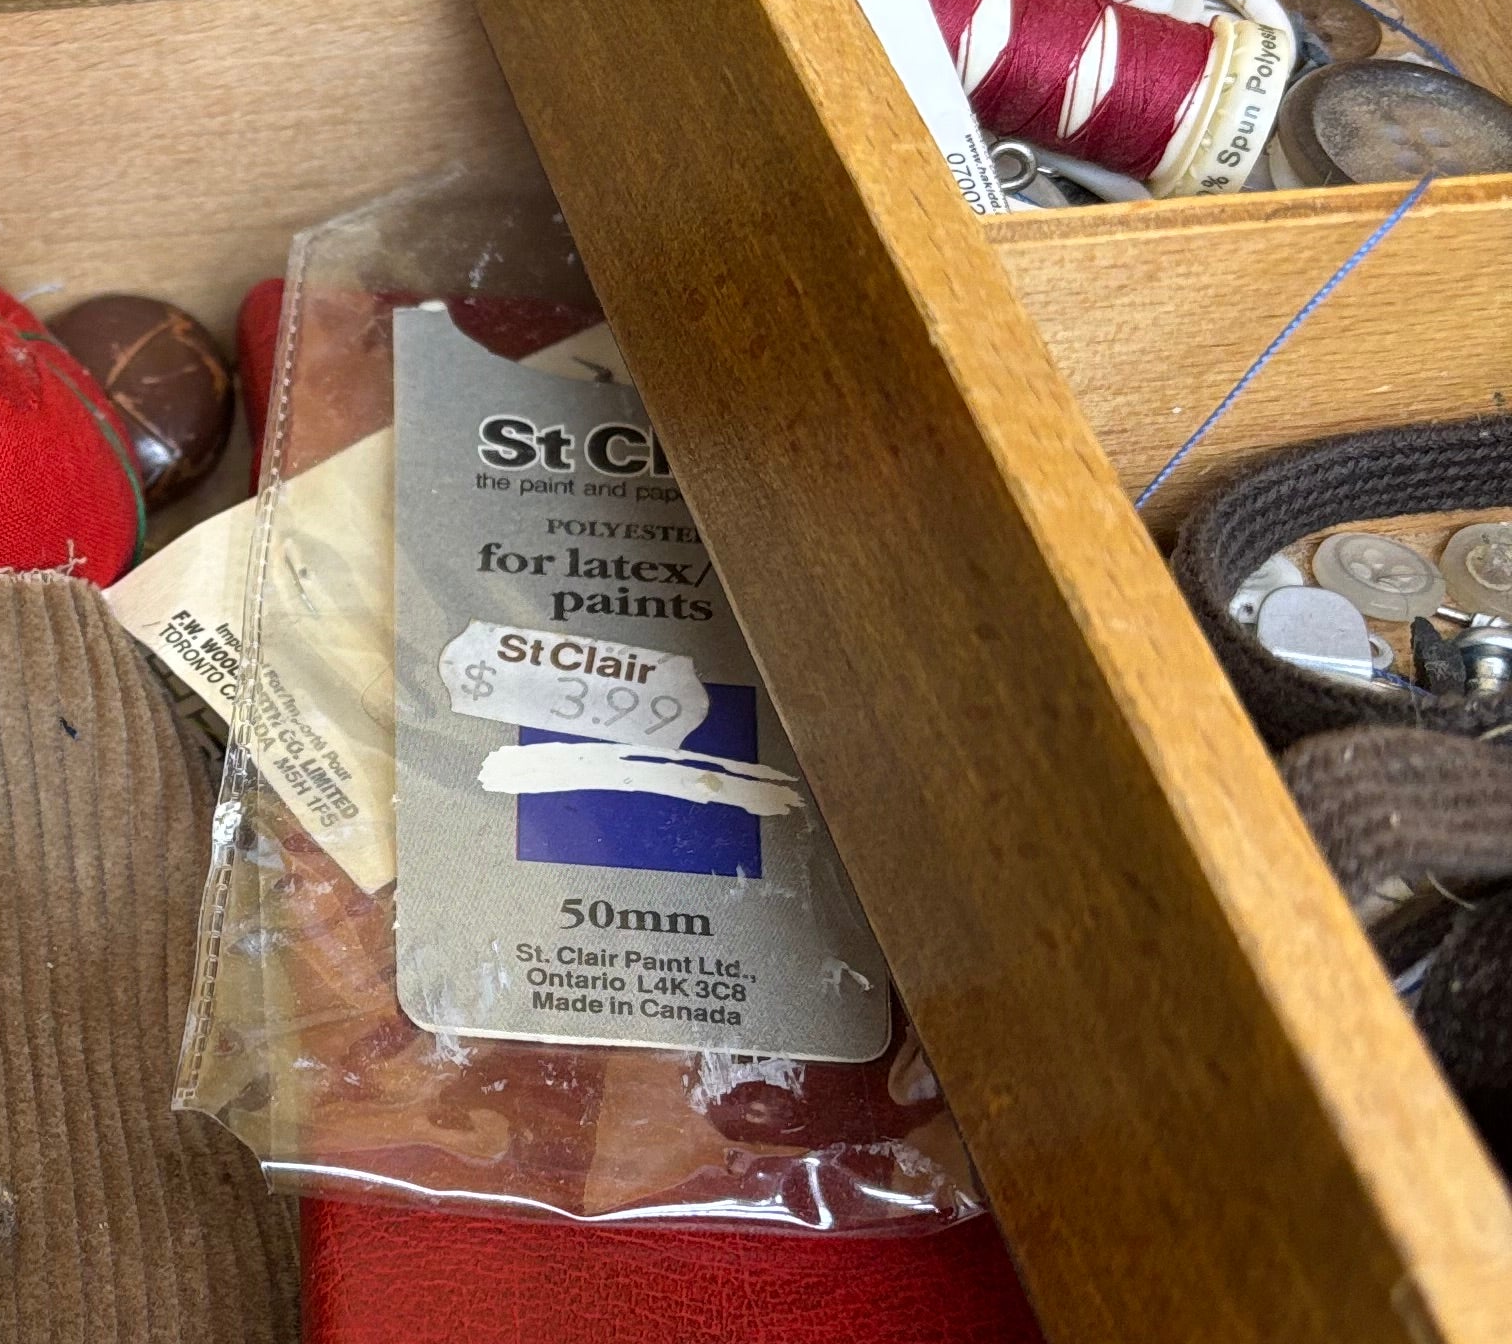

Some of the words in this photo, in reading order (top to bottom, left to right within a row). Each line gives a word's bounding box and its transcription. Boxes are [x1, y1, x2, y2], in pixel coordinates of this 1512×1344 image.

[1216, 105, 1261, 168] Spun
[478, 414, 575, 473] St
[476, 472, 511, 491] the
[520, 478, 575, 497] paint
[584, 480, 627, 499] and
[476, 542, 555, 576] for
[564, 547, 713, 588] latex/
[550, 586, 714, 622] paints
[497, 633, 545, 666] St
[549, 641, 656, 685] Clair
[159, 623, 224, 685] TORONTO
[273, 756, 311, 797] M5H
[172, 609, 206, 641] F.W.
[278, 728, 305, 761] CO.
[299, 757, 360, 821] LIMITED
[549, 676, 683, 736] 3.99
[326, 749, 353, 783] Pour
[560, 898, 715, 936] 50mm
[515, 942, 551, 964] St.
[556, 945, 619, 968] Clair
[624, 950, 693, 975] Paint
[526, 967, 627, 992] Ontario
[638, 974, 689, 998] L4K
[694, 979, 747, 1002] 3C8
[532, 990, 604, 1014] Made
[609, 996, 634, 1016] in
[639, 998, 743, 1026] Canada
